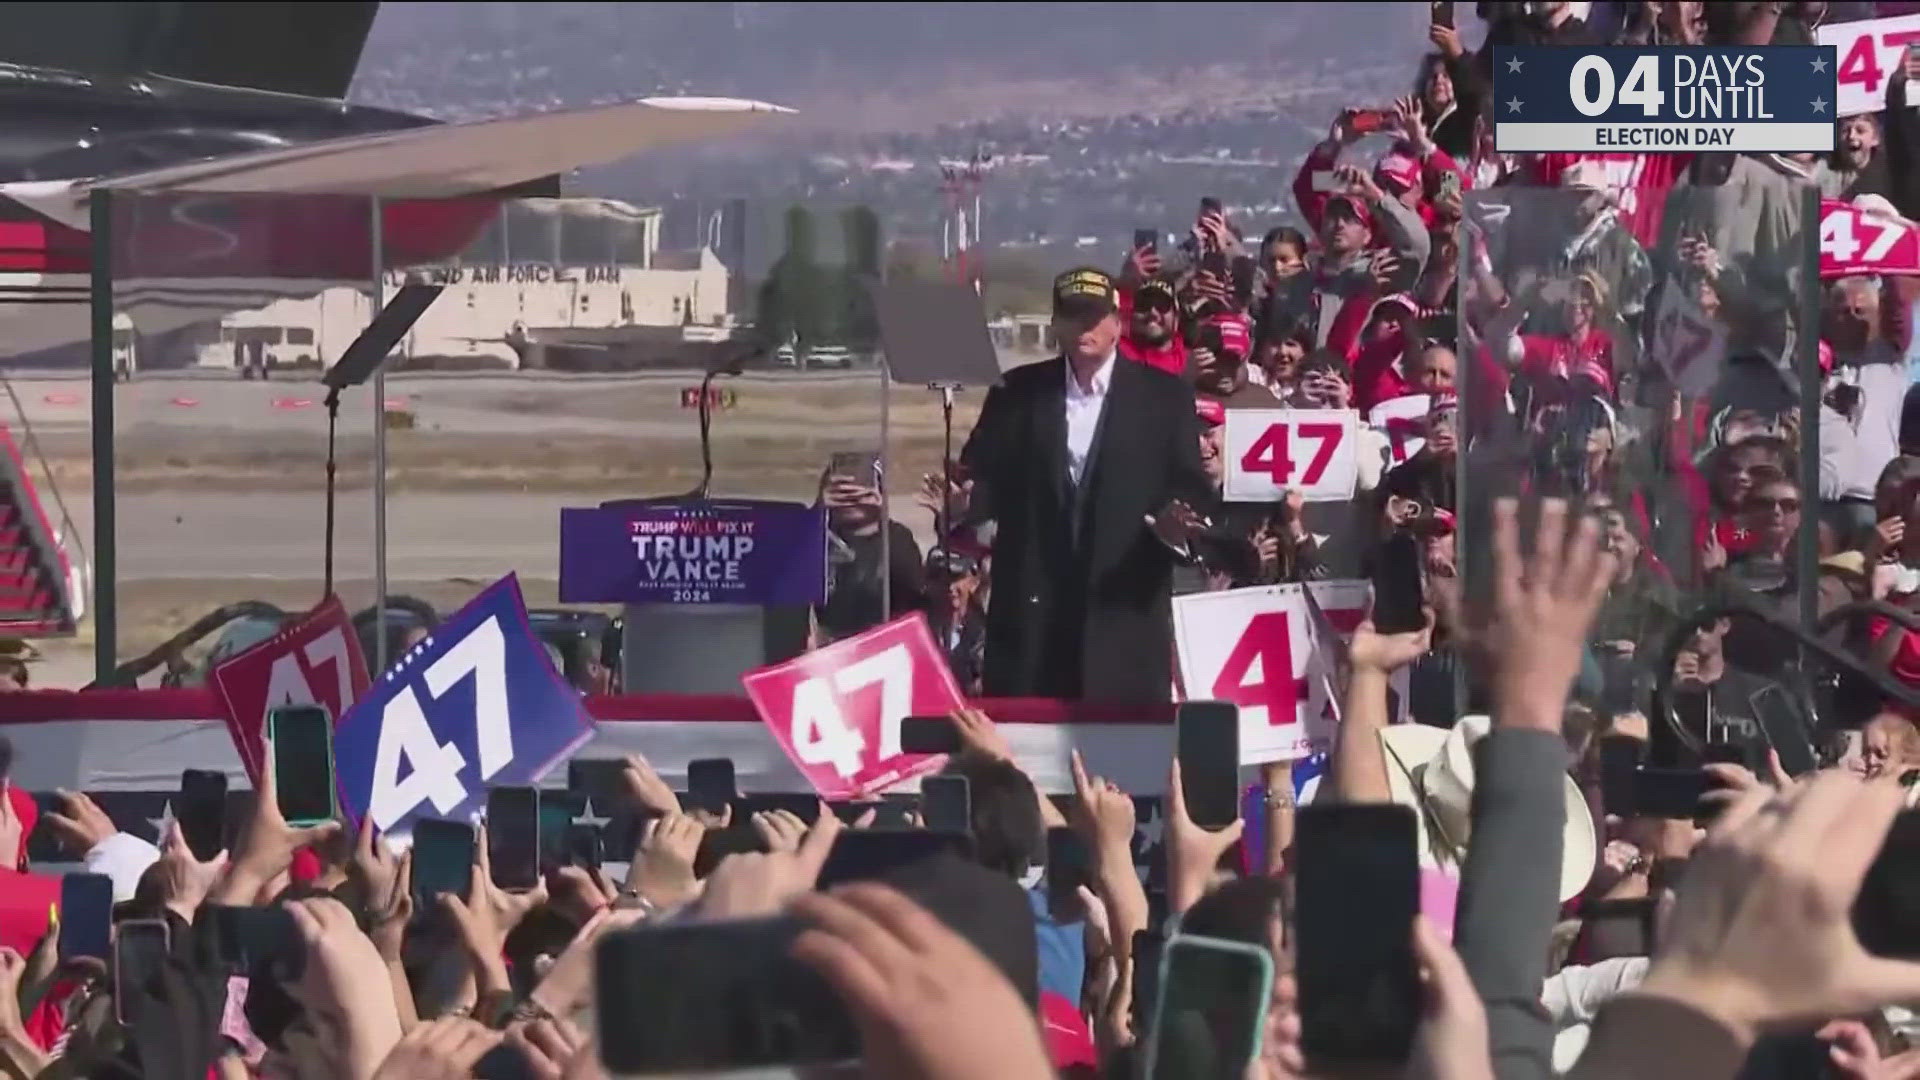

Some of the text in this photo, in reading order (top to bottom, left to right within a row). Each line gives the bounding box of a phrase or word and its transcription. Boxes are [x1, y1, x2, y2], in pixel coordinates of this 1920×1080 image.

[1820, 210, 1906, 262] 47
[1240, 423, 1344, 486] 47
[632, 521, 678, 533] TRUMP
[742, 521, 755, 533] IT
[631, 535, 754, 560] TRUMP
[646, 560, 740, 580] VANCE
[673, 590, 711, 602] 2024
[369, 614, 514, 833] 47
[791, 642, 913, 778] 47
